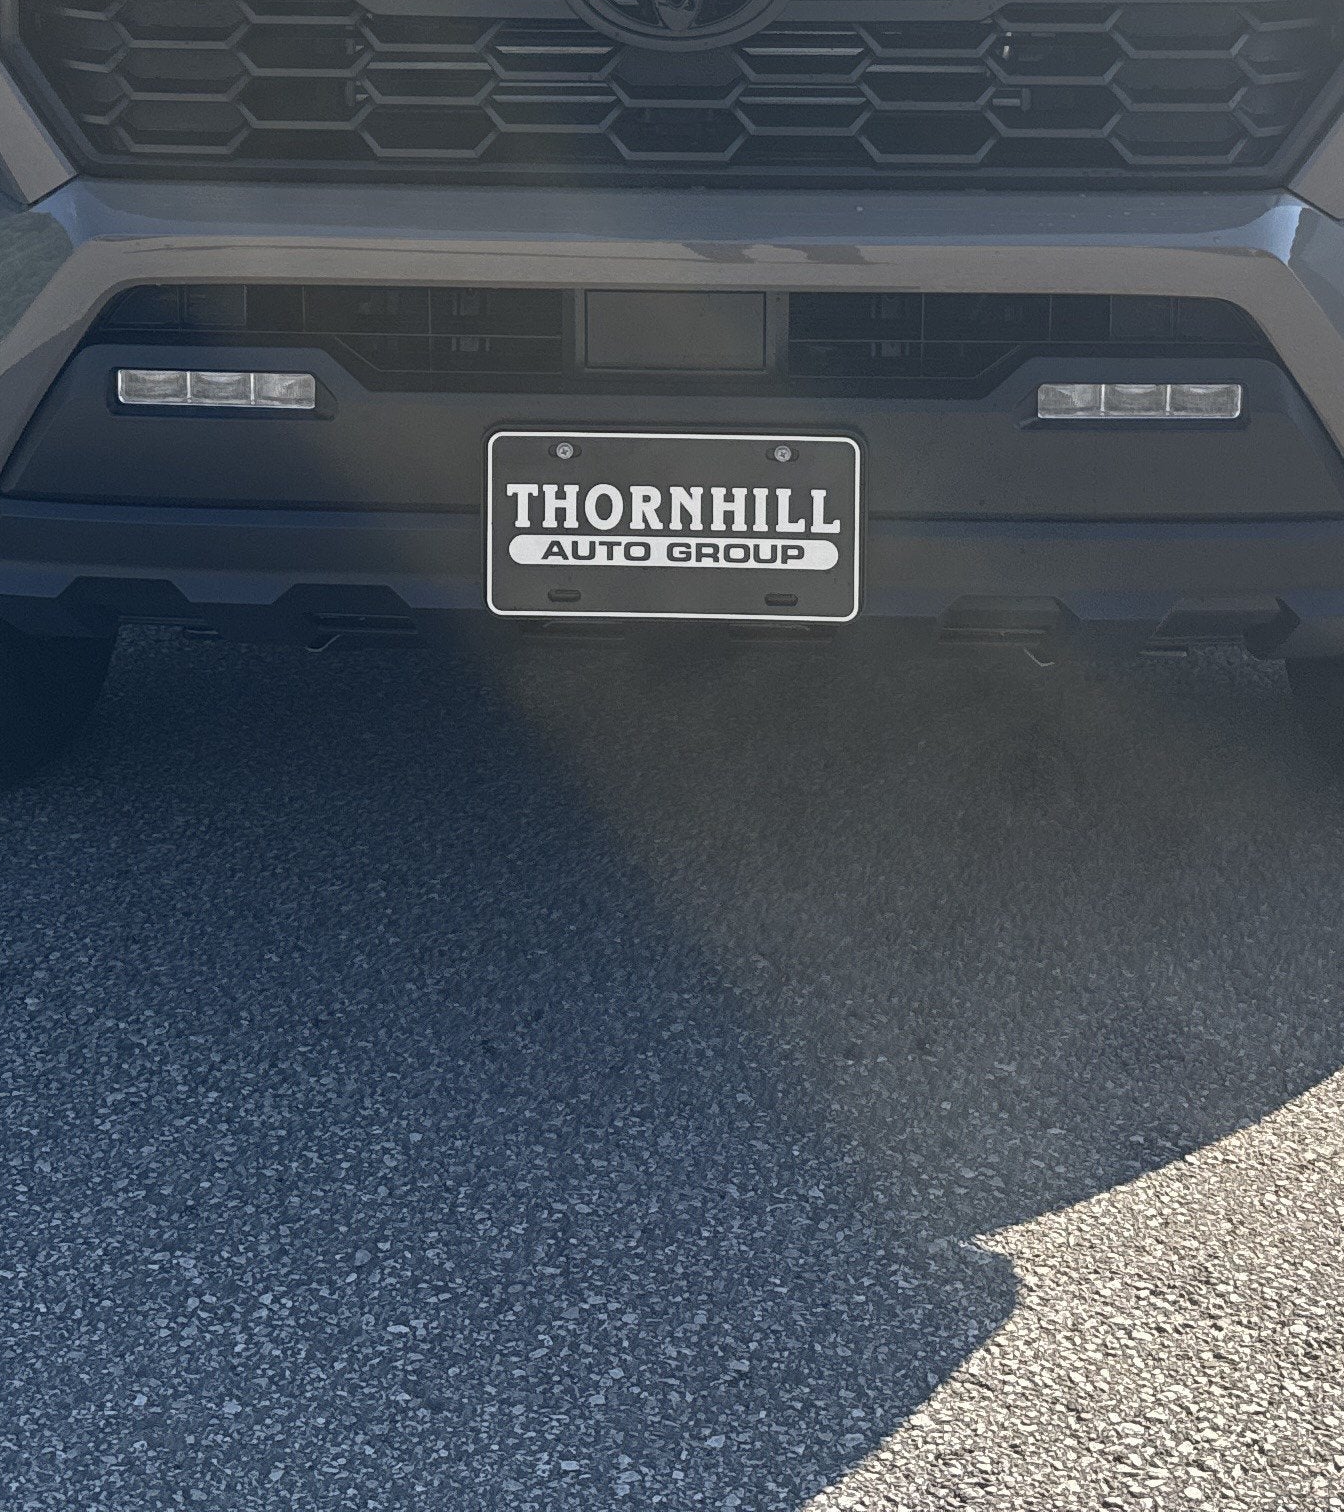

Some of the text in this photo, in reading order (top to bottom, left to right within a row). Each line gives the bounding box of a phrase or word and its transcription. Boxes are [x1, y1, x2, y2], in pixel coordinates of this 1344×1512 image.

[506, 483, 841, 534] THORNHILL
[541, 540, 805, 565] AUTO GROUP
